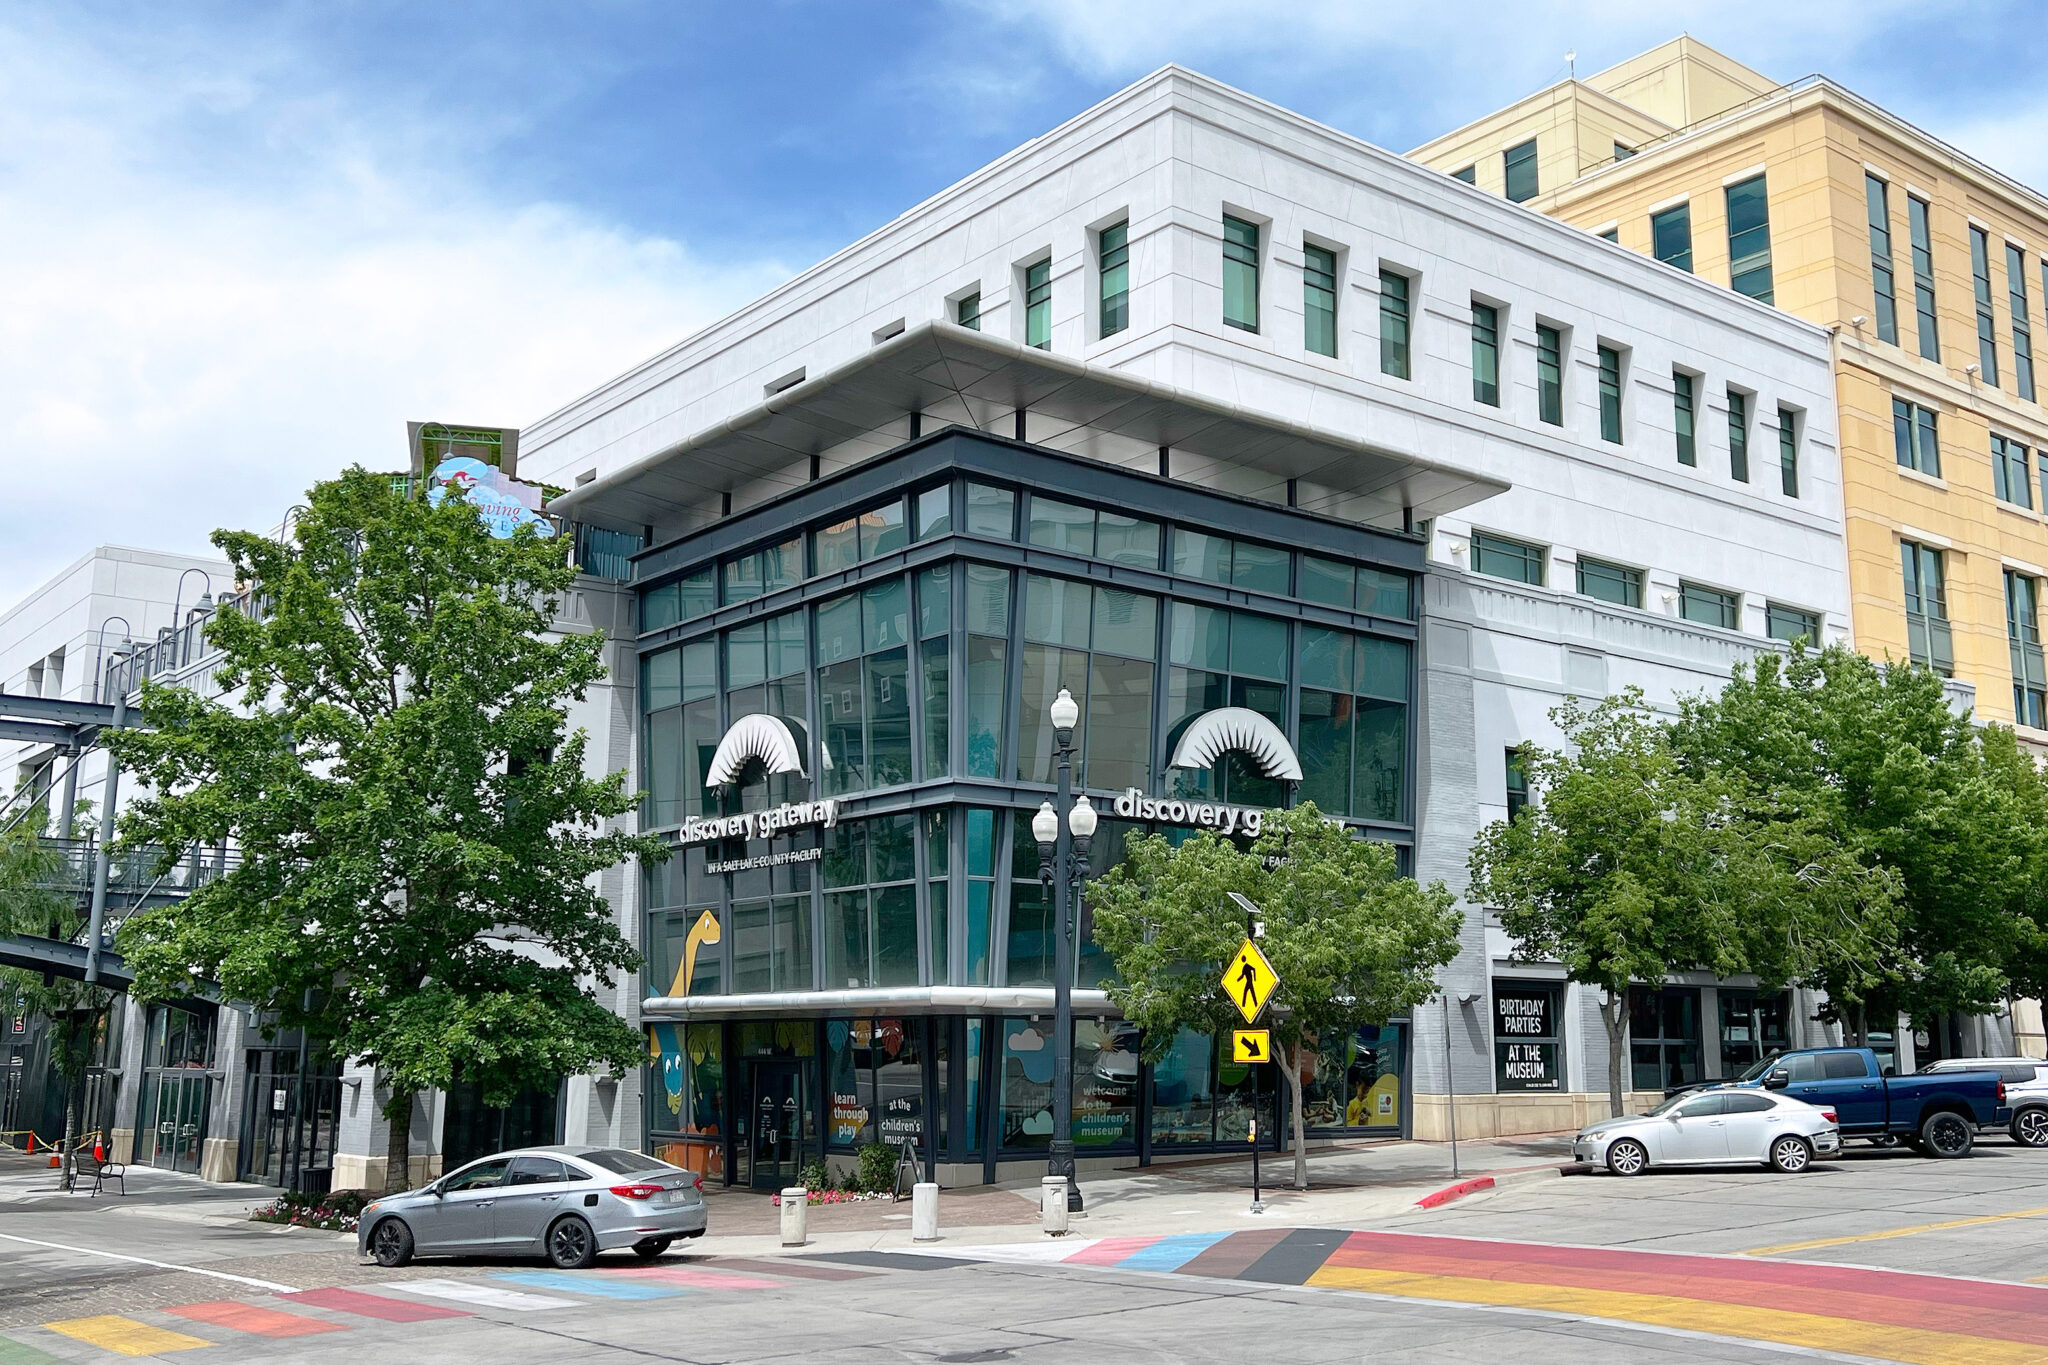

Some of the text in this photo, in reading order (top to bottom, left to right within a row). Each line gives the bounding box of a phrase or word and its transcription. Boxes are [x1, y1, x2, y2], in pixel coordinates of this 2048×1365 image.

[1113, 786, 1239, 835] discovery
[679, 799, 839, 844] discovery gateway
[723, 860, 740, 872] SALT
[740, 857, 758, 870] LAKE
[759, 852, 790, 868] COUNTY
[790, 847, 823, 864] FACILITY
[1499, 999, 1545, 1016] BIRTHDAY
[1505, 1016, 1542, 1033] PARTIES
[1508, 1045, 1541, 1061] AT THE
[1506, 1062, 1545, 1079] MUSEUM
[834, 1092, 856, 1104] learn
[1083, 1086, 1127, 1096] welcome
[889, 1098, 911, 1111] at the
[1095, 1100, 1112, 1110] the
[833, 1106, 869, 1122] through
[1081, 1112, 1130, 1123] children's
[838, 1123, 857, 1139] play
[881, 1119, 921, 1132] children's
[1081, 1127, 1123, 1136] museum
